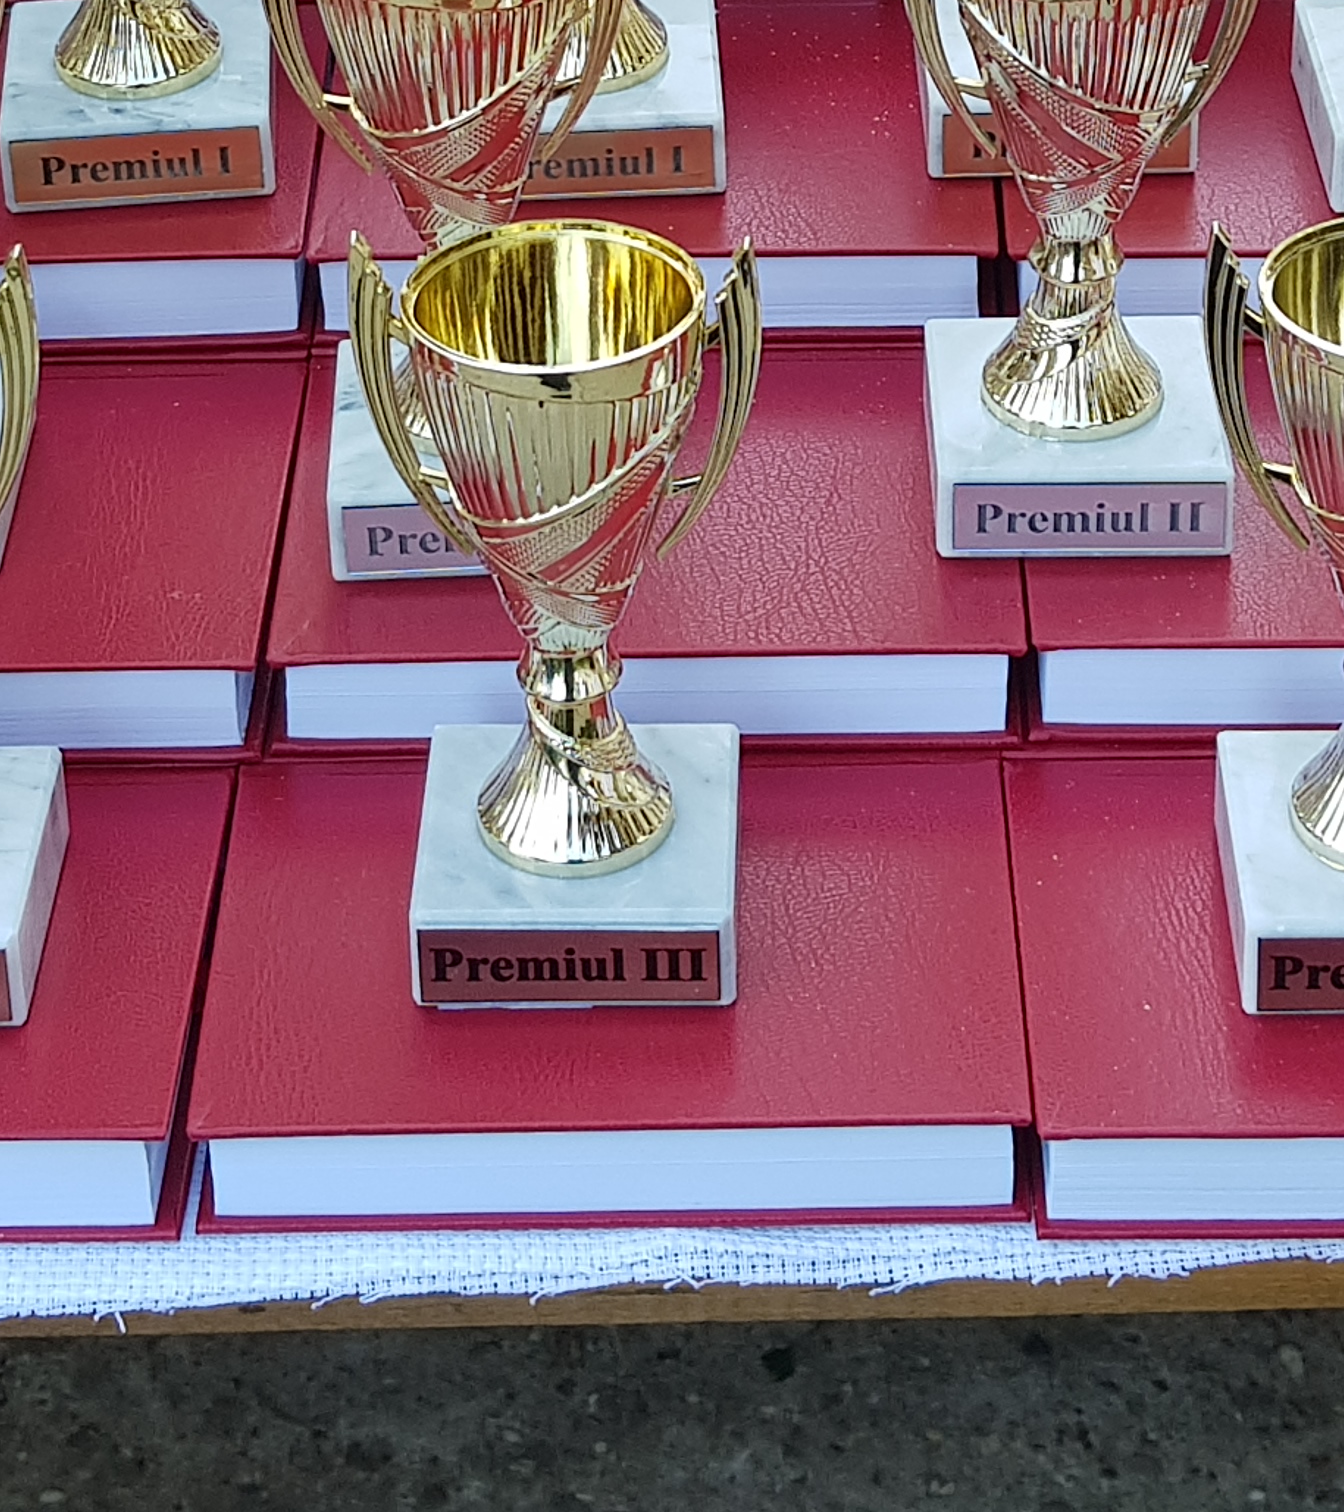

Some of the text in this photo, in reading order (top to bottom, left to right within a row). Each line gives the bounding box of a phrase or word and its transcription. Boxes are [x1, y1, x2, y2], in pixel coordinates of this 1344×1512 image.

[40, 145, 231, 187] Premiul I
[527, 145, 684, 181] remiul I
[976, 501, 1205, 534] Premiul II
[428, 946, 709, 983] Premiul III
